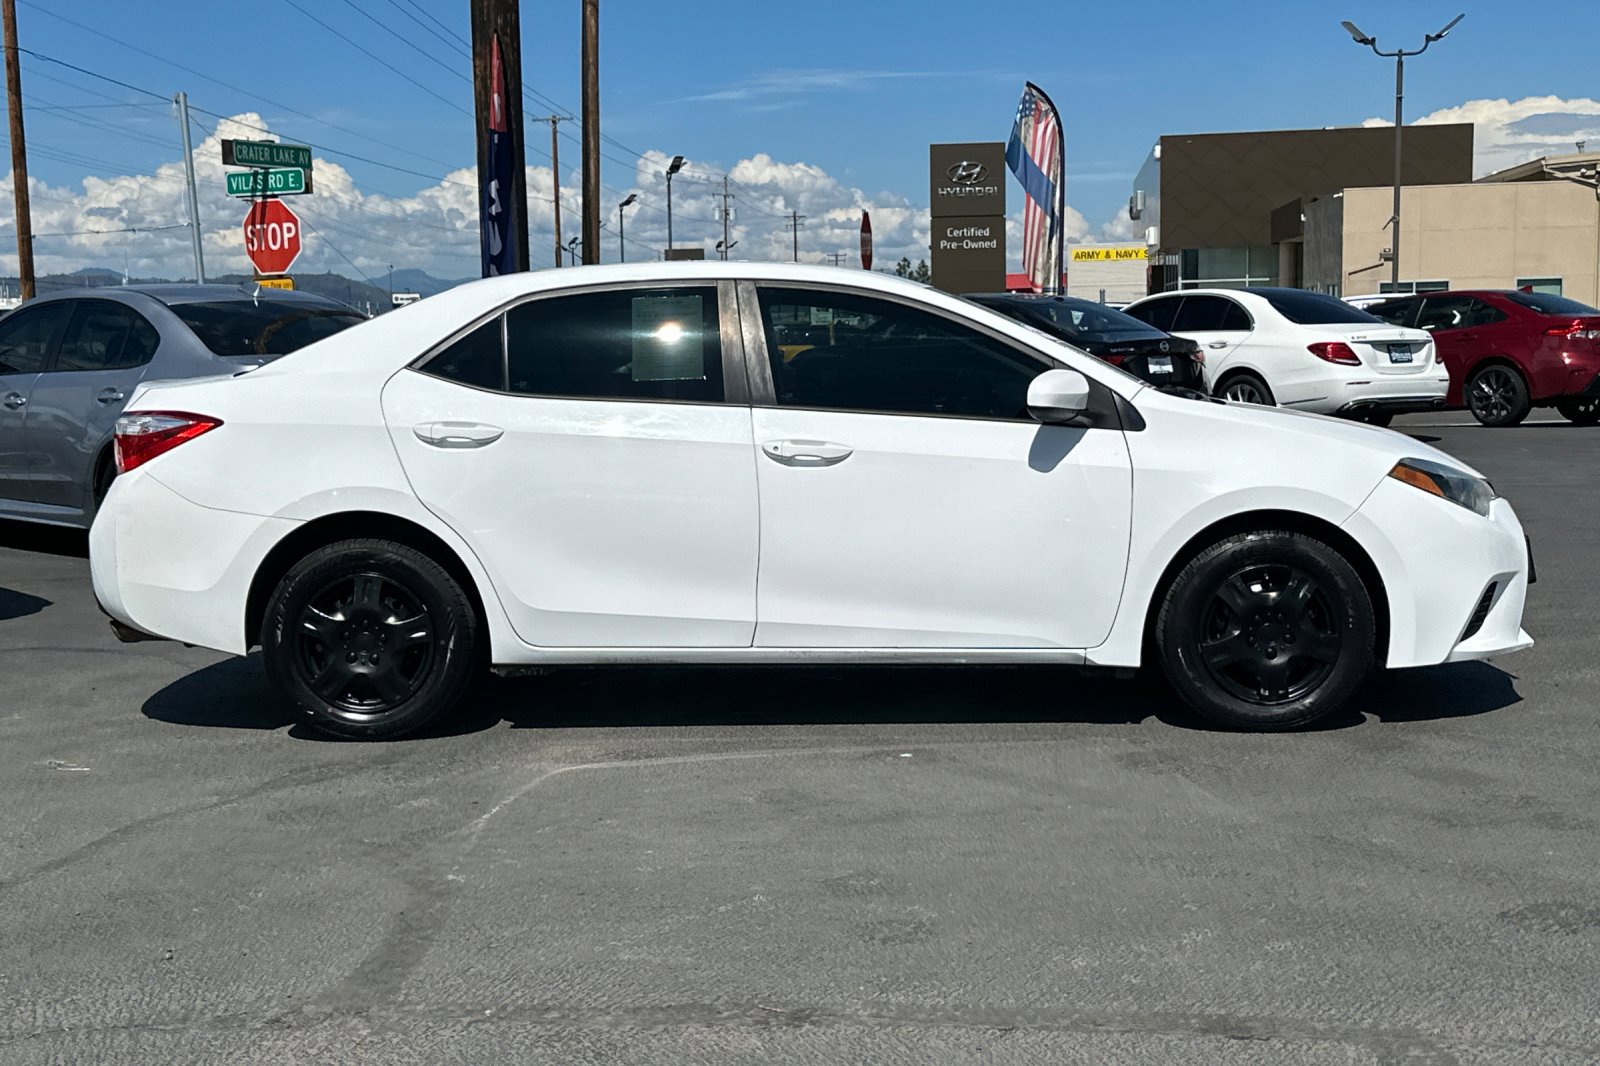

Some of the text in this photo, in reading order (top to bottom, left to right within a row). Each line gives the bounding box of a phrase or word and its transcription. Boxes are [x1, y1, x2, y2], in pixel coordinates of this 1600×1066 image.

[236, 144, 271, 161] CRATER
[273, 148, 296, 163] LAKE
[230, 175, 263, 191] VILAS
[268, 174, 284, 188] RD
[938, 186, 998, 197] HYUNDAI
[247, 222, 296, 252] STOP
[946, 227, 990, 237] Certified
[940, 239, 997, 250] Pre-Owned
[1074, 250, 1101, 260] ARMY
[1104, 250, 1111, 259] &
[1115, 249, 1140, 259] NAVY
